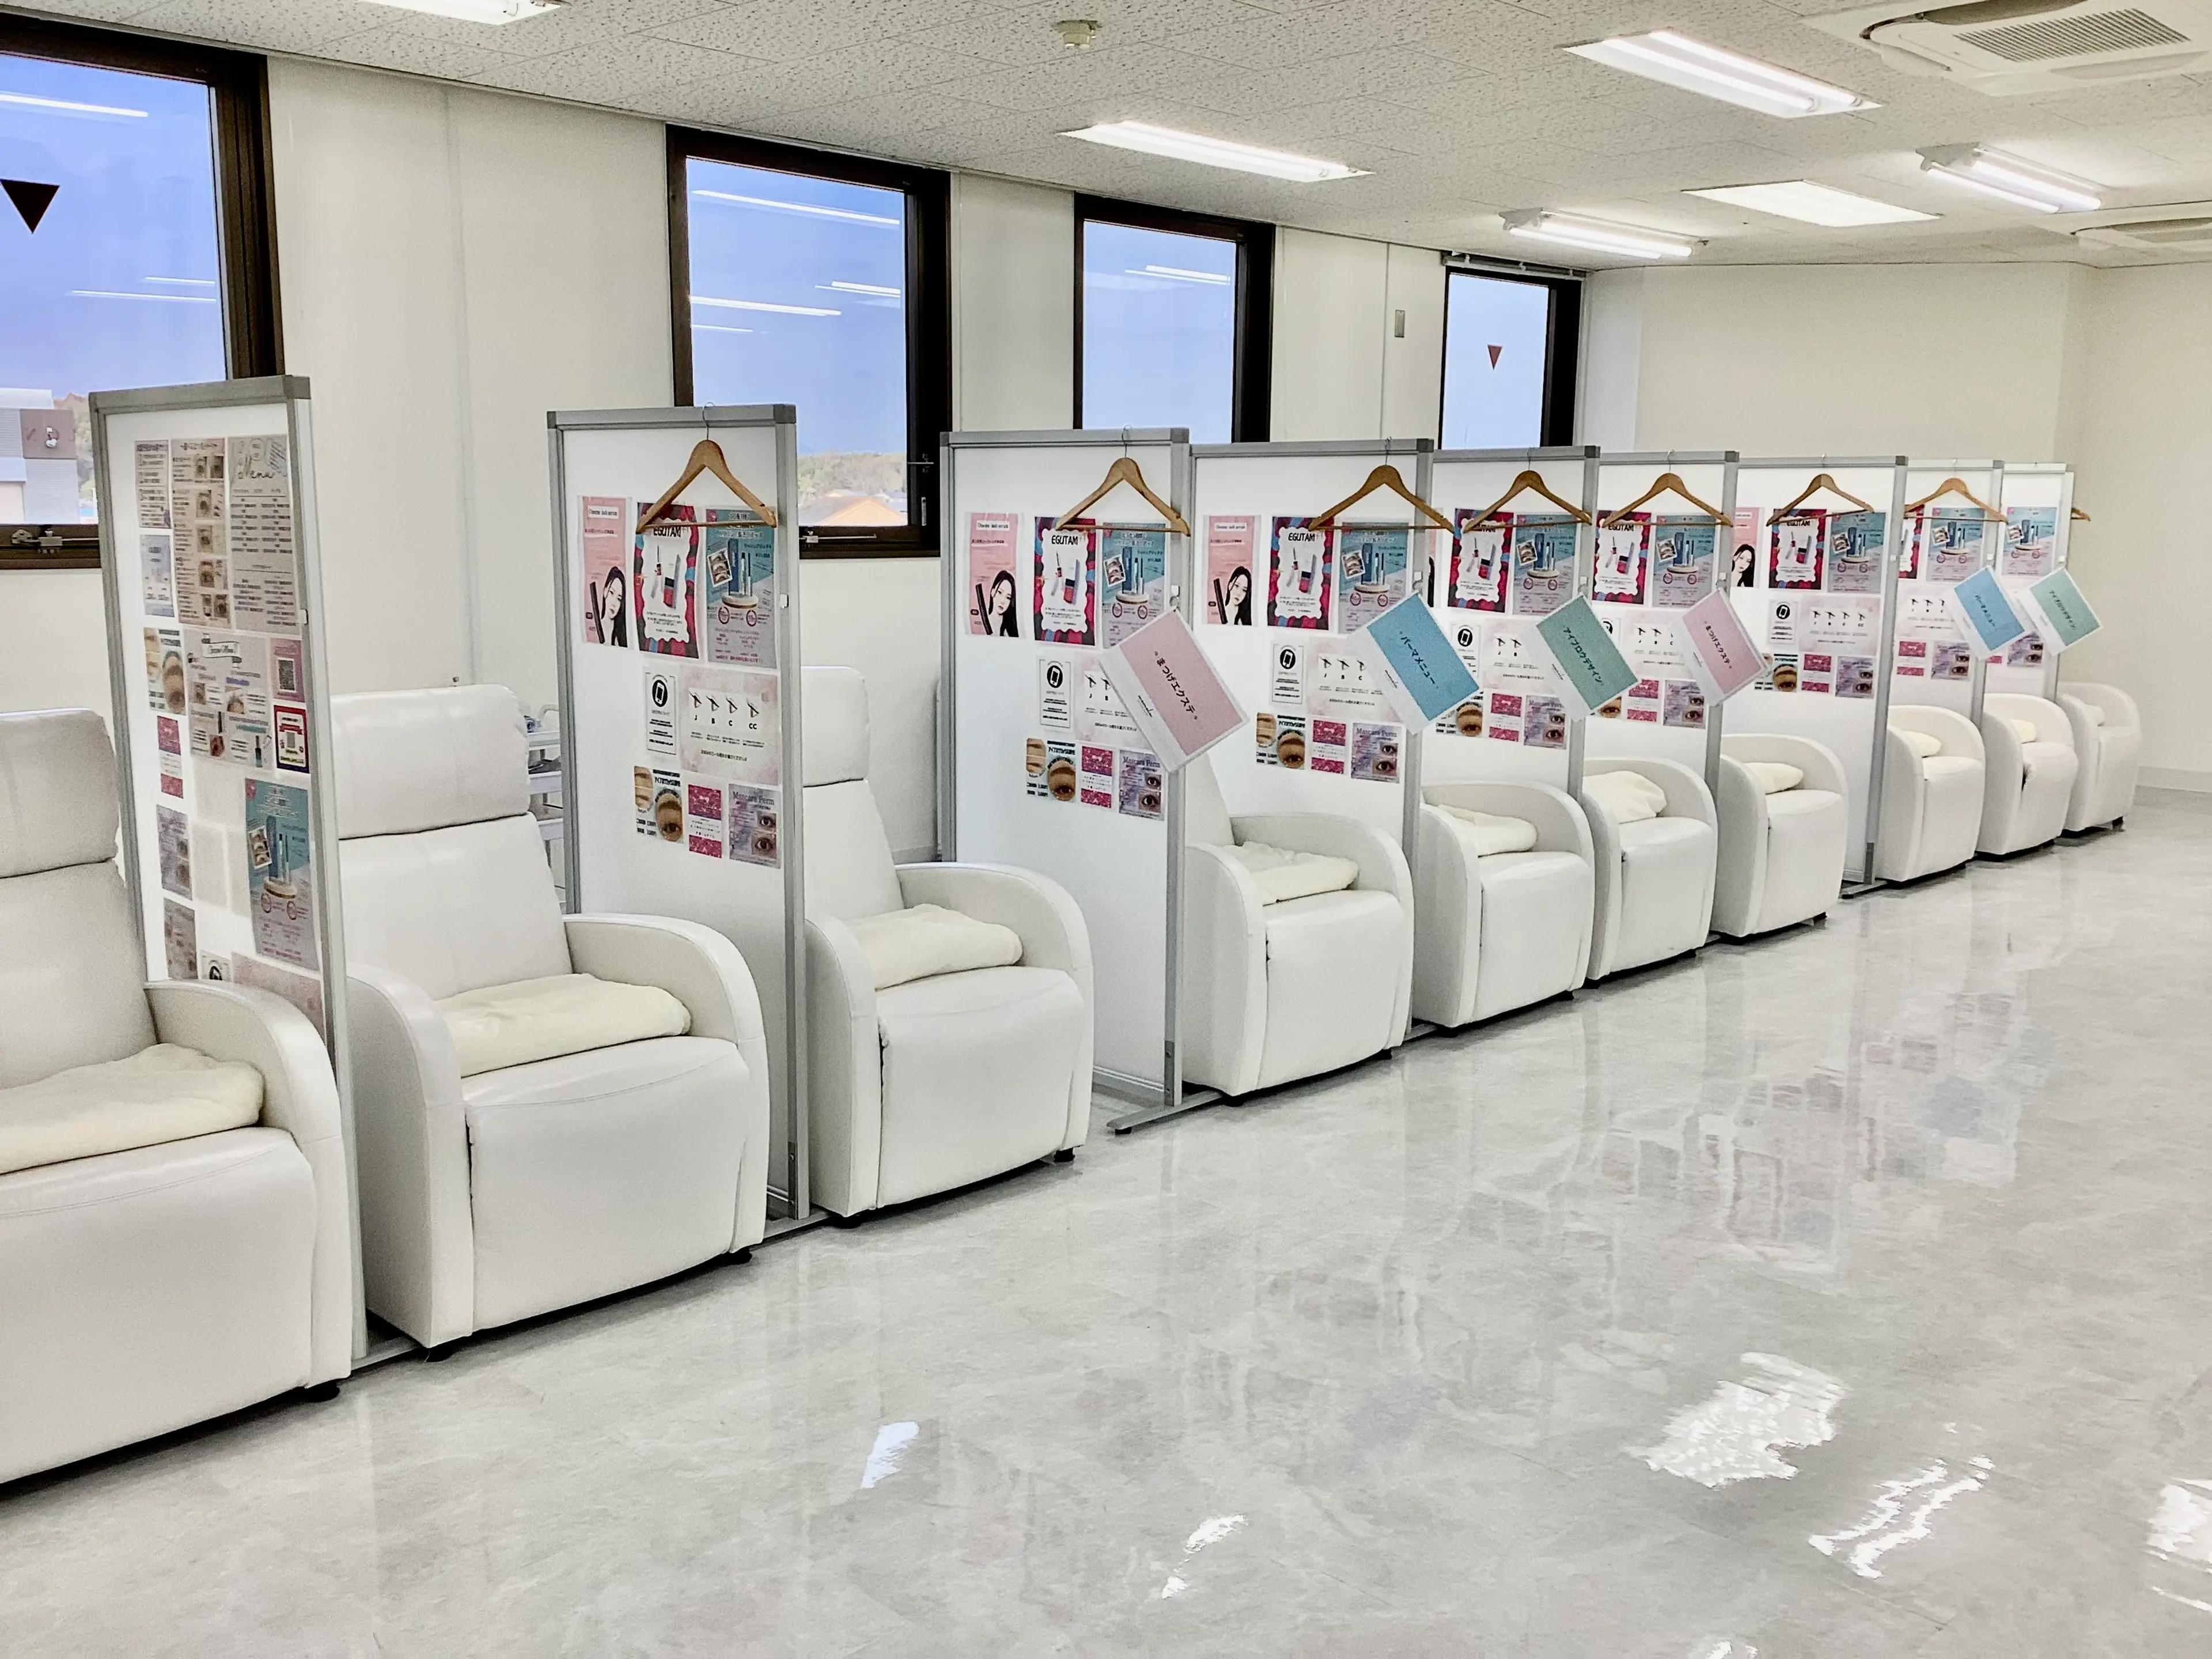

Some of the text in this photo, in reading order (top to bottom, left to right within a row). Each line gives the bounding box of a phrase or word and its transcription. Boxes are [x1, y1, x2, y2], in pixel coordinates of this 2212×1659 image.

[1051, 535, 1078, 545] EGUTAM
[1288, 532, 1316, 542] EGUTAM
[1156, 657, 1195, 714] まつげエクステ
